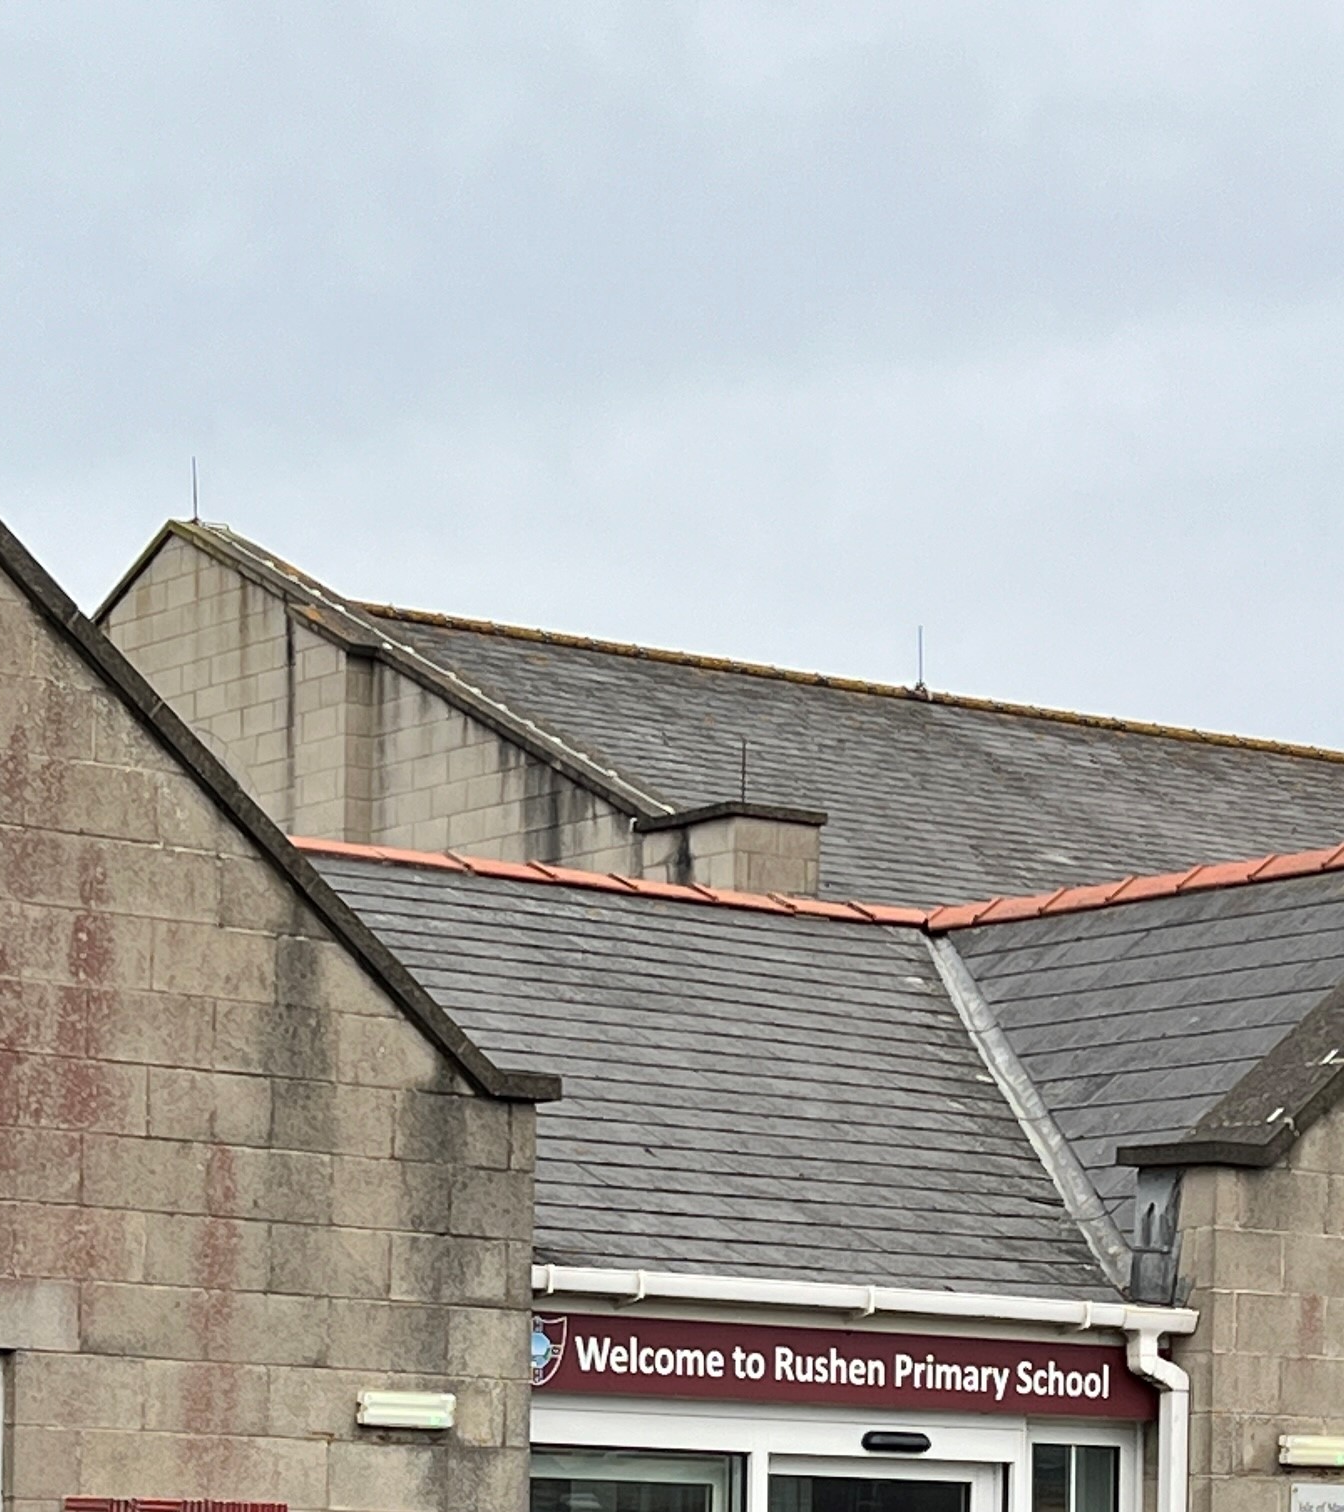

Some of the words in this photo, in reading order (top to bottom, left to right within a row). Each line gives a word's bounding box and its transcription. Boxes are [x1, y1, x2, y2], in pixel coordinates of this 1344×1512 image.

[575, 1335, 725, 1379] Welcome
[732, 1345, 766, 1380] to
[774, 1346, 886, 1387] Rushen
[894, 1353, 1011, 1401] Primary
[1015, 1360, 1111, 1399] School
